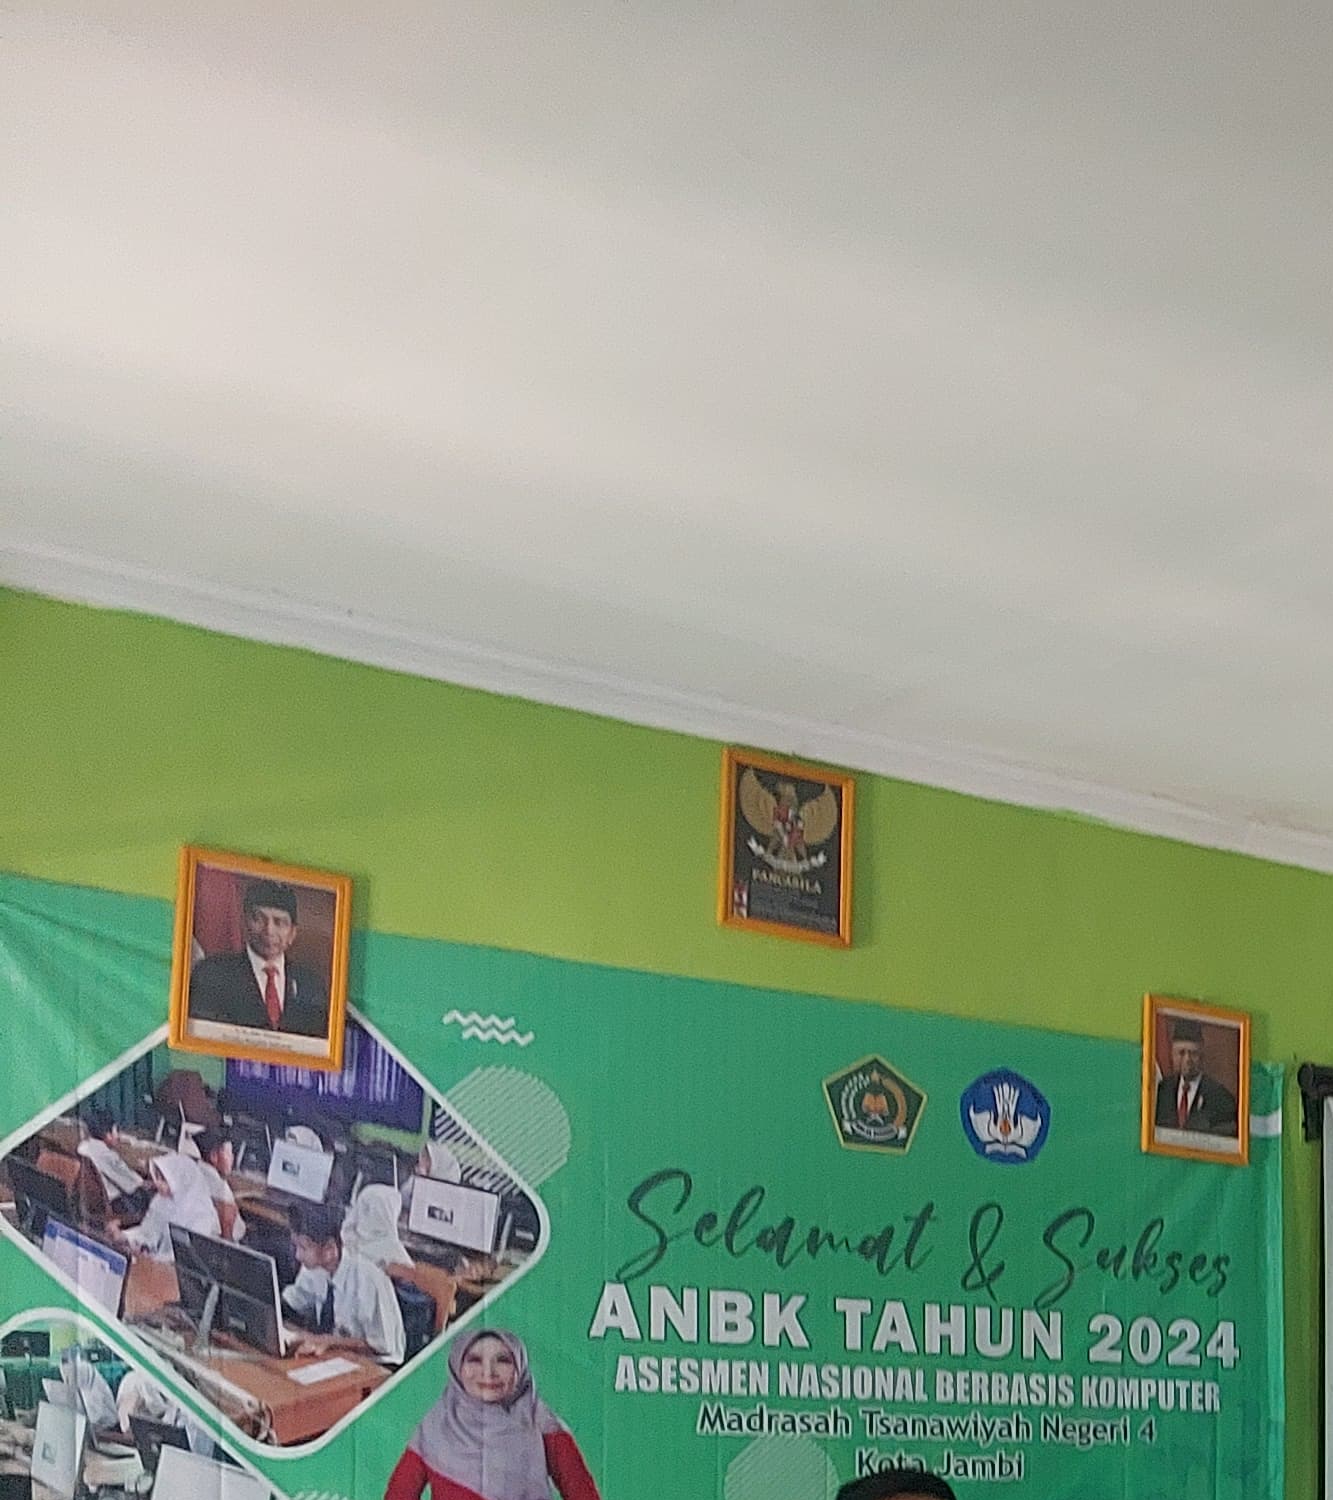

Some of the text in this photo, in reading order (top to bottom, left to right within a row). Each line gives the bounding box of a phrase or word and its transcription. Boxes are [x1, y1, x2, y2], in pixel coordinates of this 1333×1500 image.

[615, 1167, 1231, 1309] Selamat & Sukses
[587, 1280, 1241, 1370] ANBK TAHUN 2024
[614, 1354, 1221, 1414] ASESMEN NASIONAL BERBASIS KOMPUTER
[697, 1402, 1156, 1450] Madrasah Tsanawiyah Negeri 4
[936, 1448, 1024, 1481] Jambi
